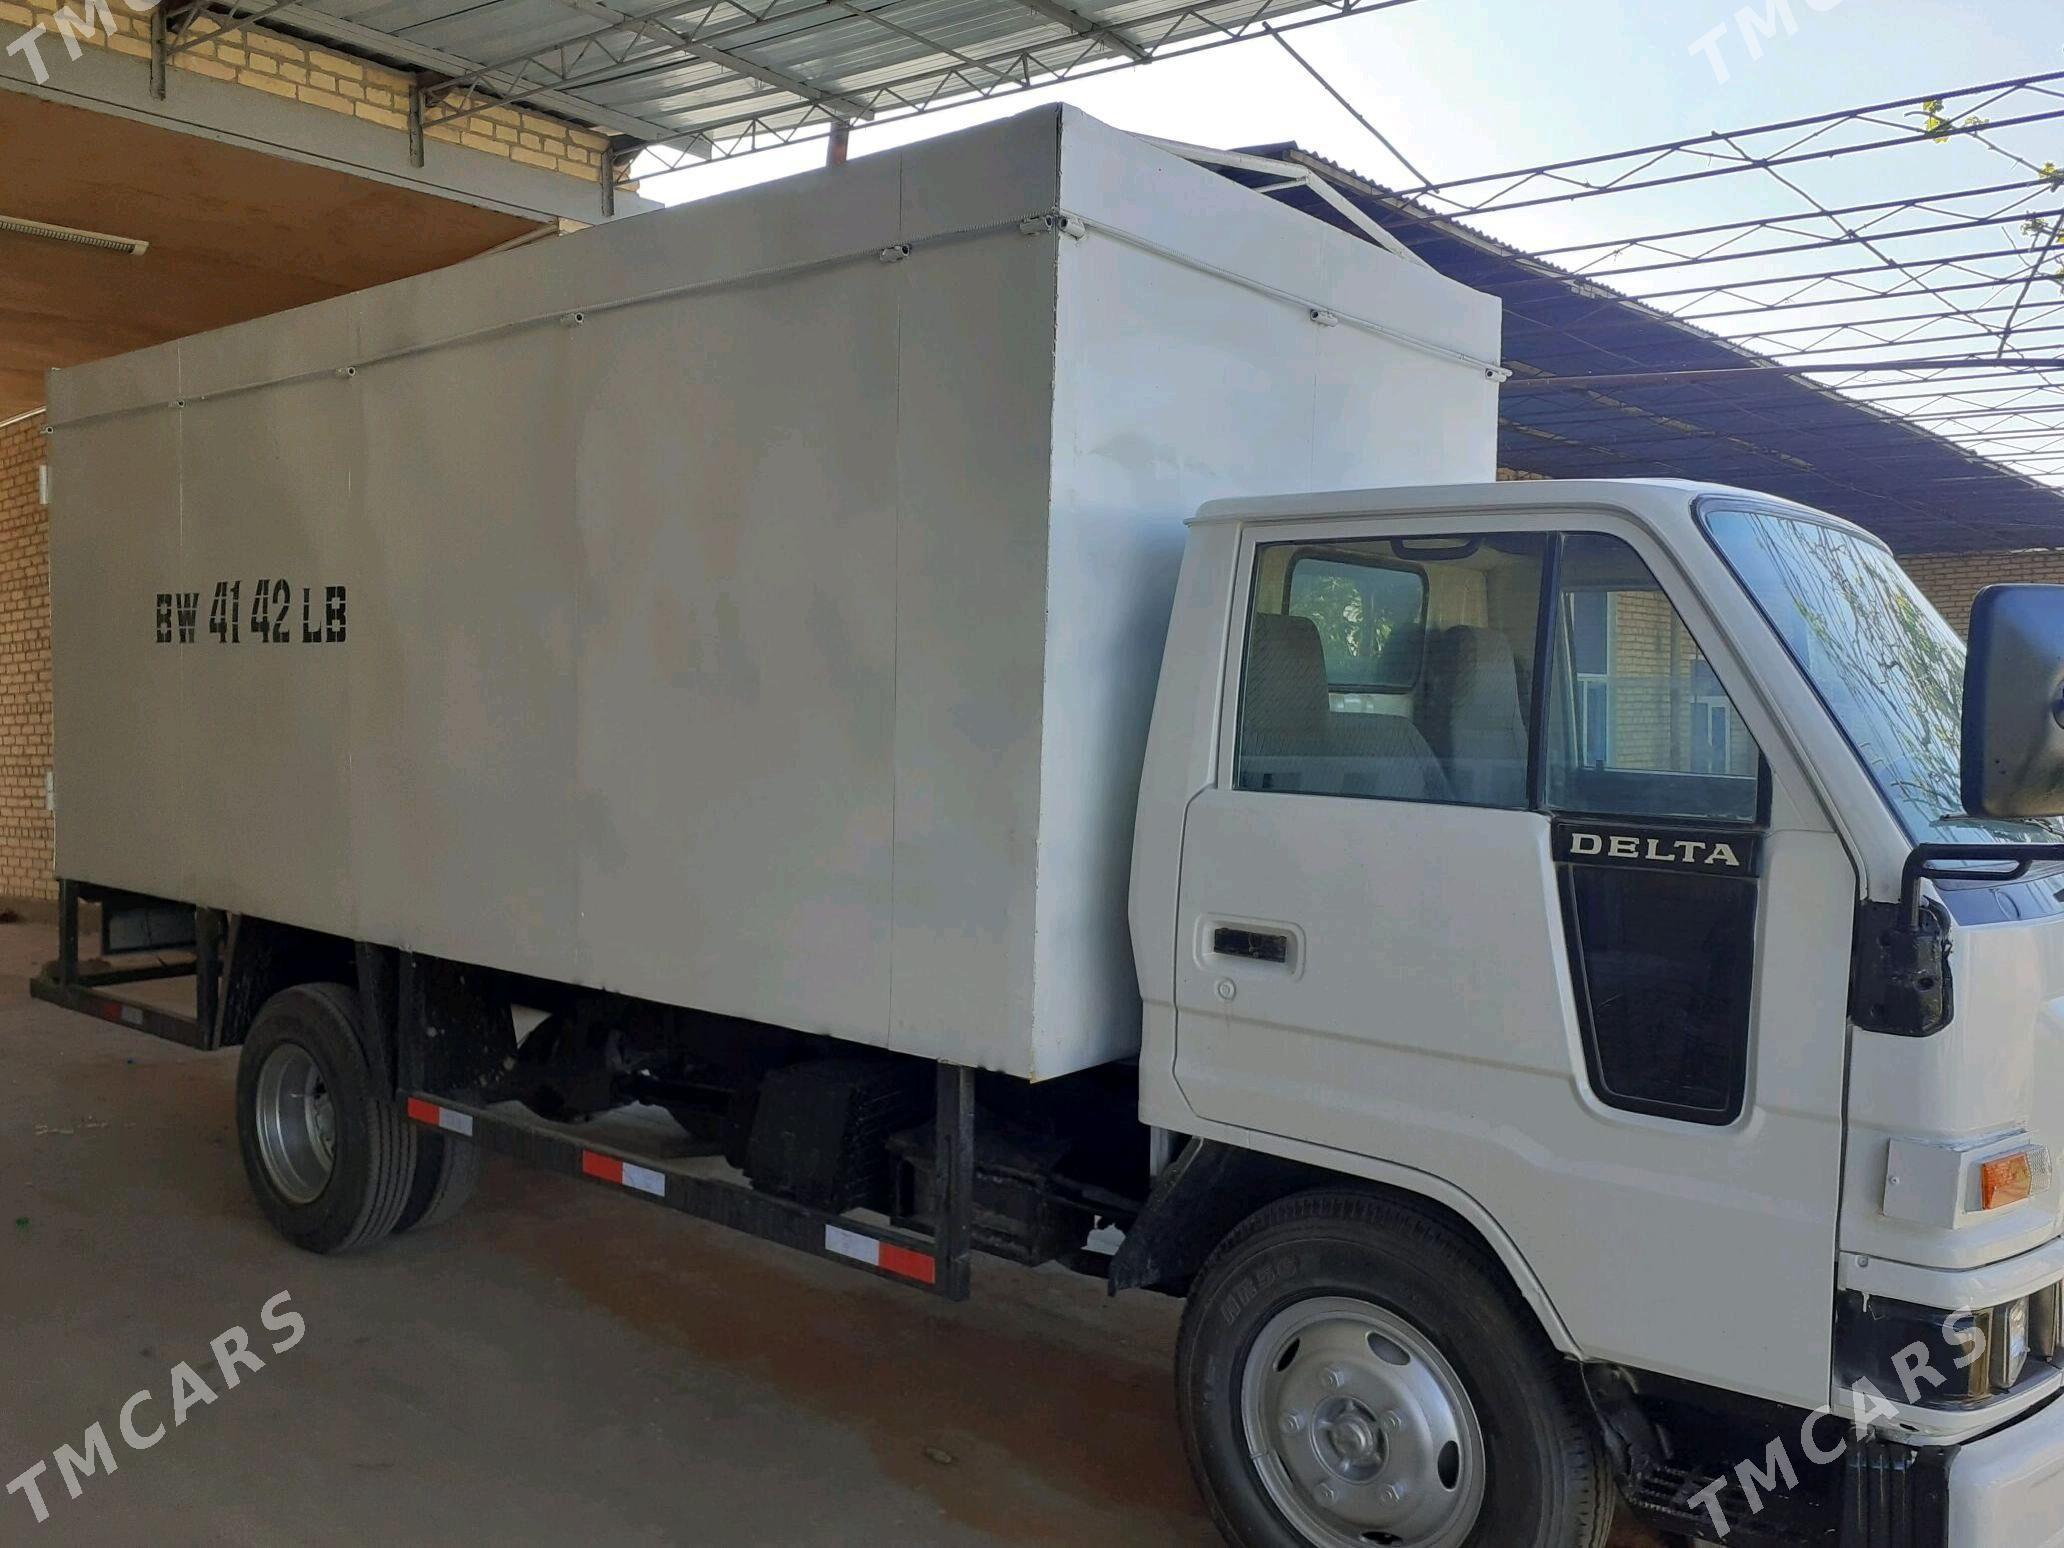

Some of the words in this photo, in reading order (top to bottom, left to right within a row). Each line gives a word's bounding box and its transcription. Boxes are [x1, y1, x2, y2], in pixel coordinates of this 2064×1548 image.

[156, 593, 200, 643] BW
[302, 586, 346, 643] LB
[1570, 832, 1740, 867] DELTA
